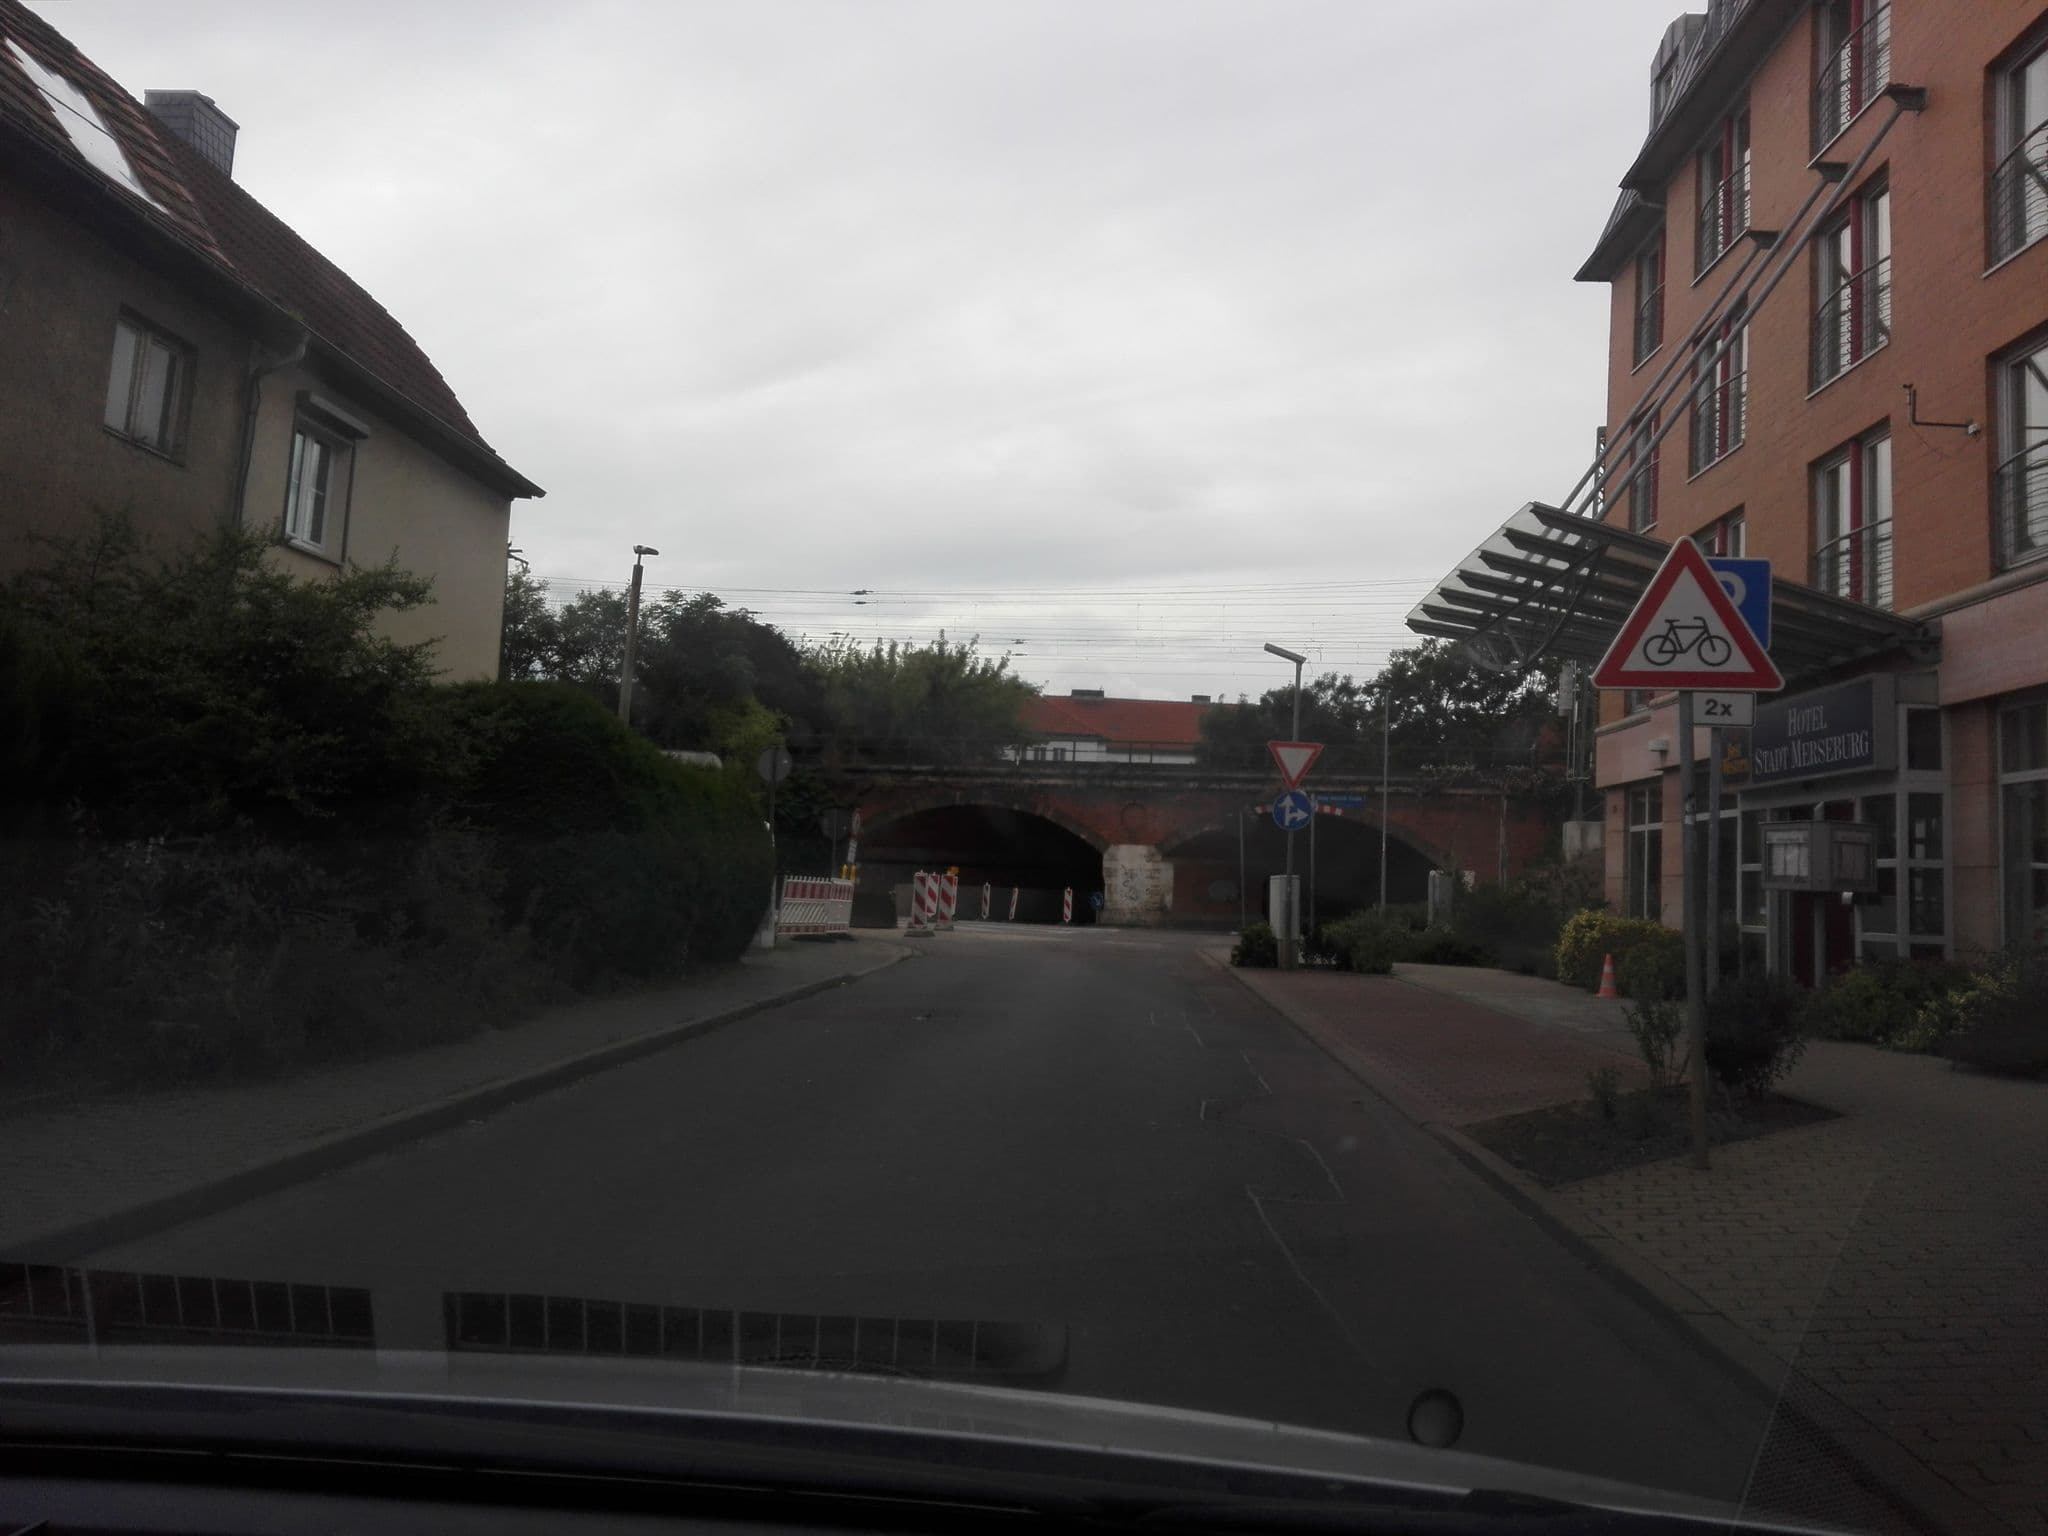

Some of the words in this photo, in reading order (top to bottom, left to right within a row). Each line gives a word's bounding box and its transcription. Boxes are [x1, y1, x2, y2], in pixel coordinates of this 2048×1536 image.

[1704, 698, 1733, 718] 2x
[1788, 705, 1828, 737] HOTEL
[1755, 746, 1789, 776] STADT
[1790, 730, 1870, 769] MERSEBURG
